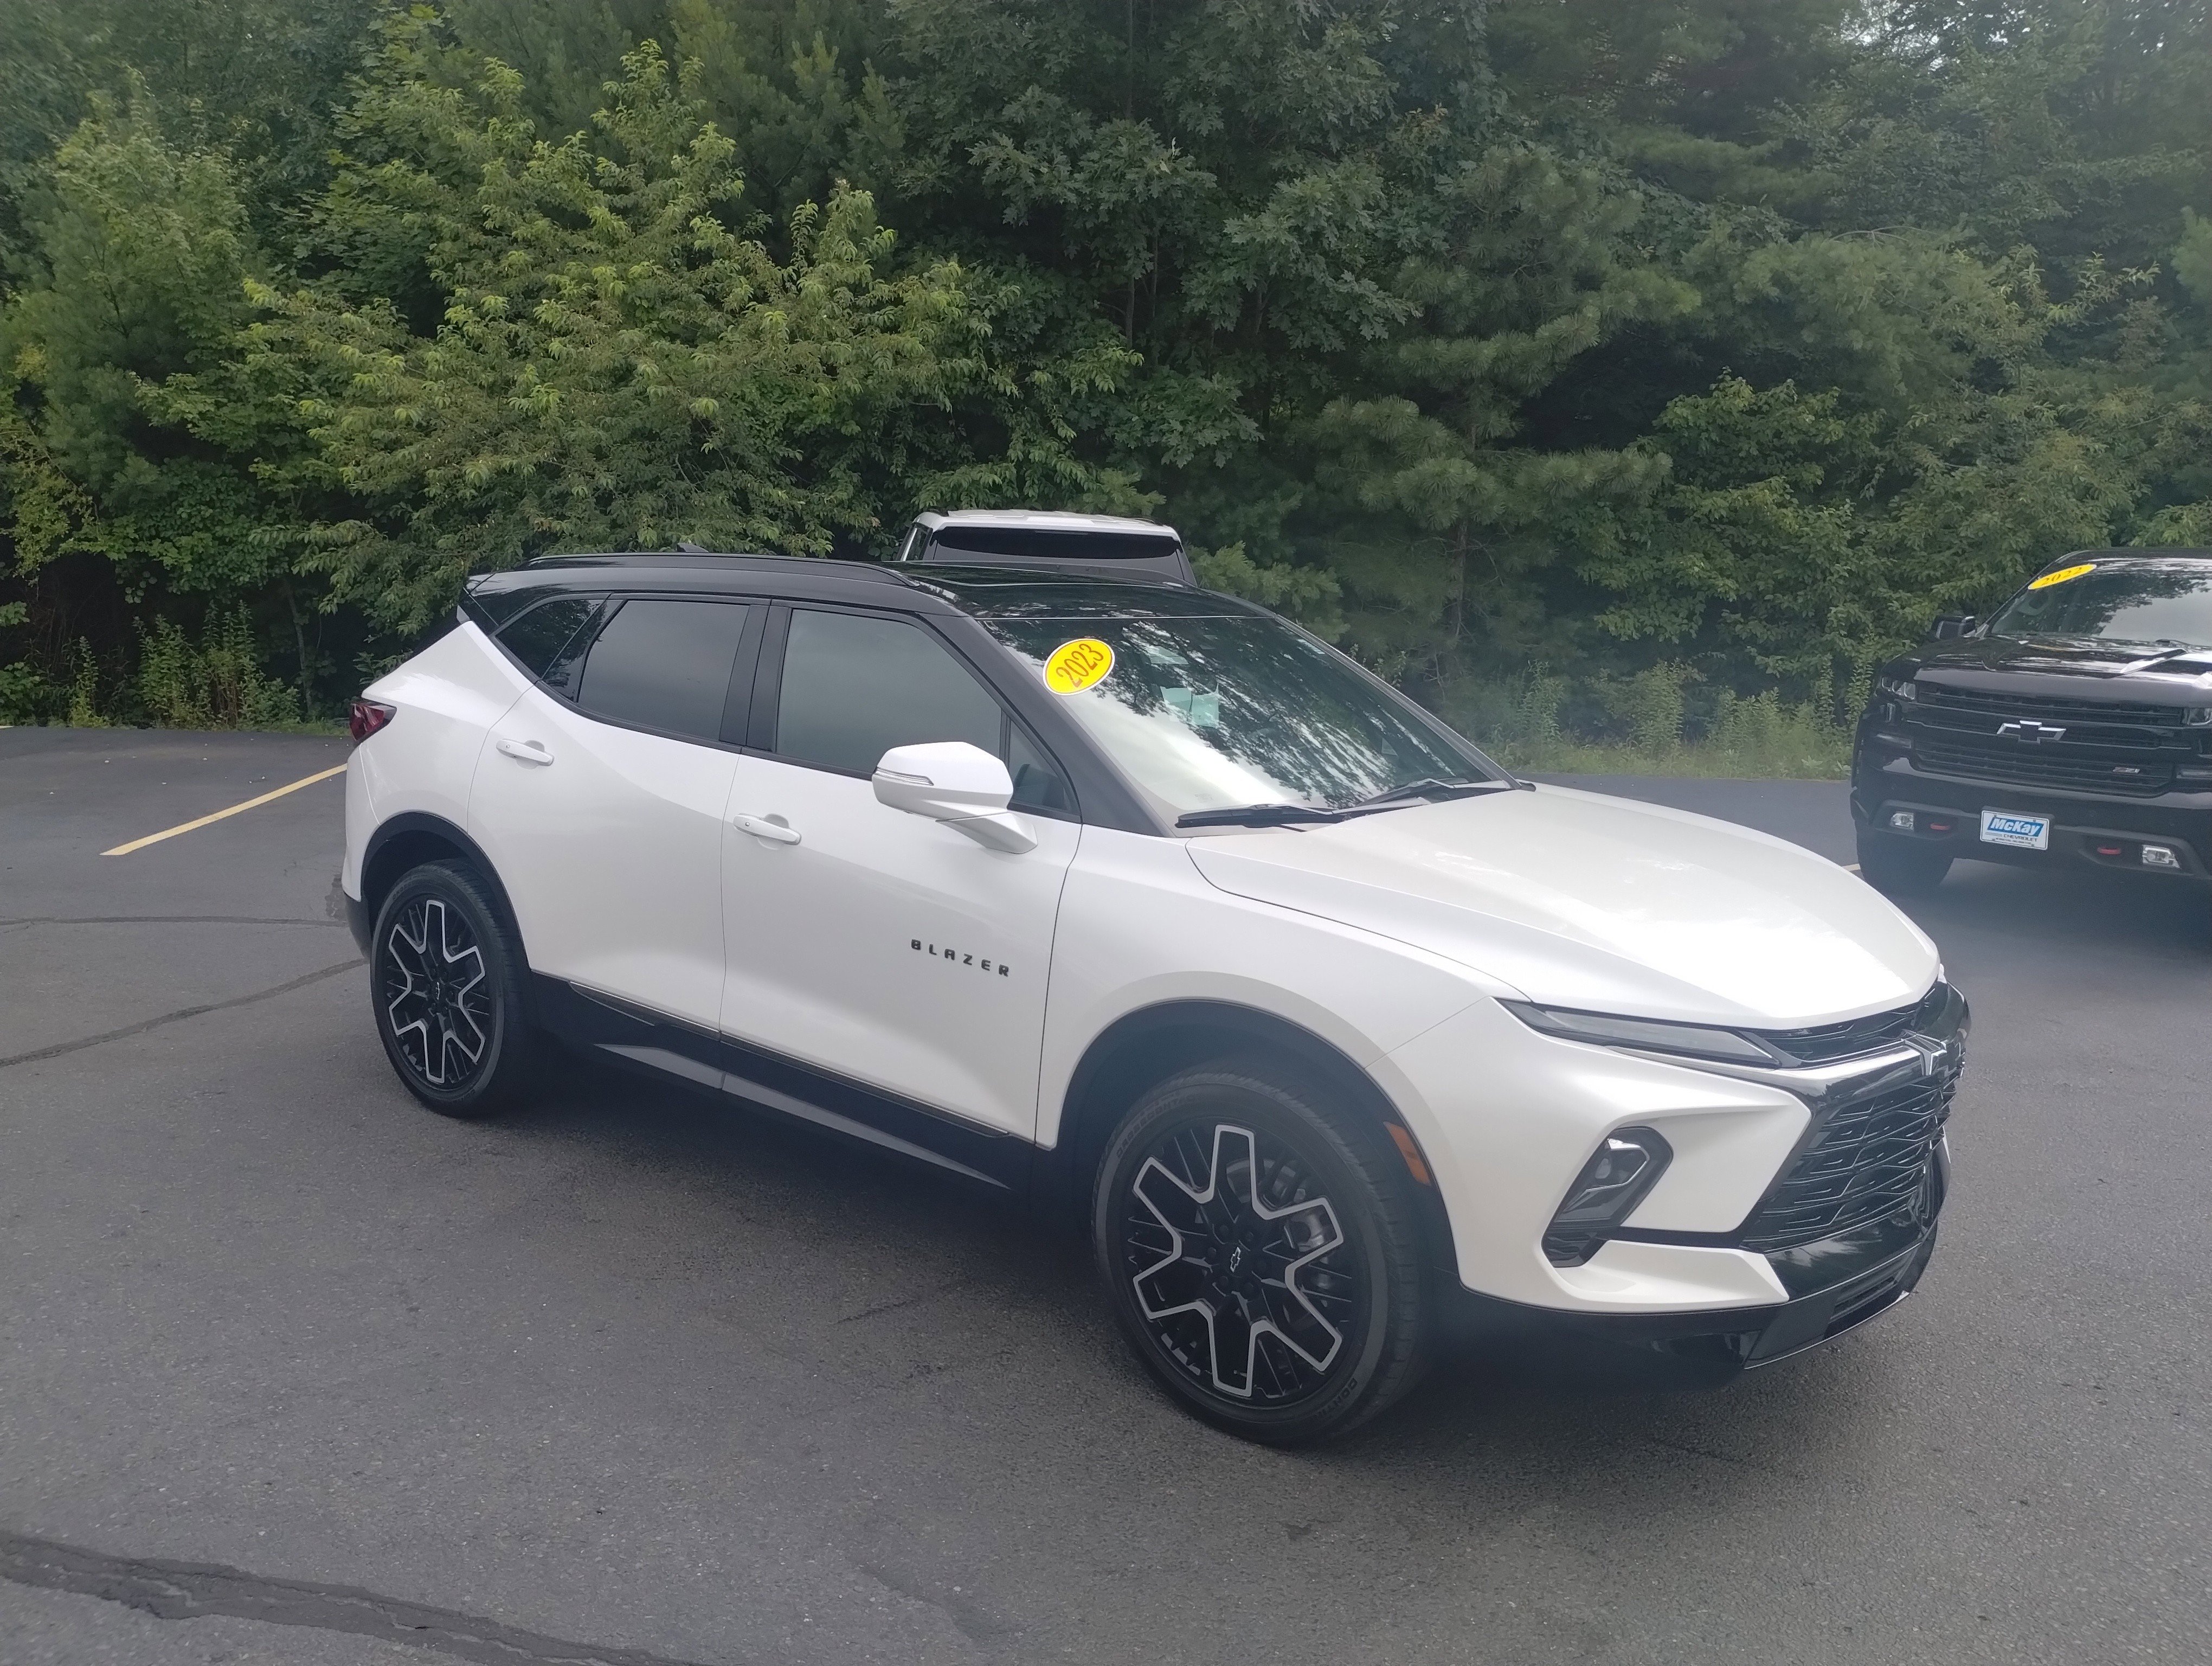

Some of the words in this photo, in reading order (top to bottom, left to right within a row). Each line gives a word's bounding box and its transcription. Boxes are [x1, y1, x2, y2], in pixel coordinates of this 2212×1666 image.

[2041, 567, 2082, 586] 2022
[1056, 644, 1103, 688] 2023
[1990, 818, 2040, 835] McKay
[2004, 834, 2037, 842] CHEVROLET
[911, 939, 1010, 977] BLAZER
